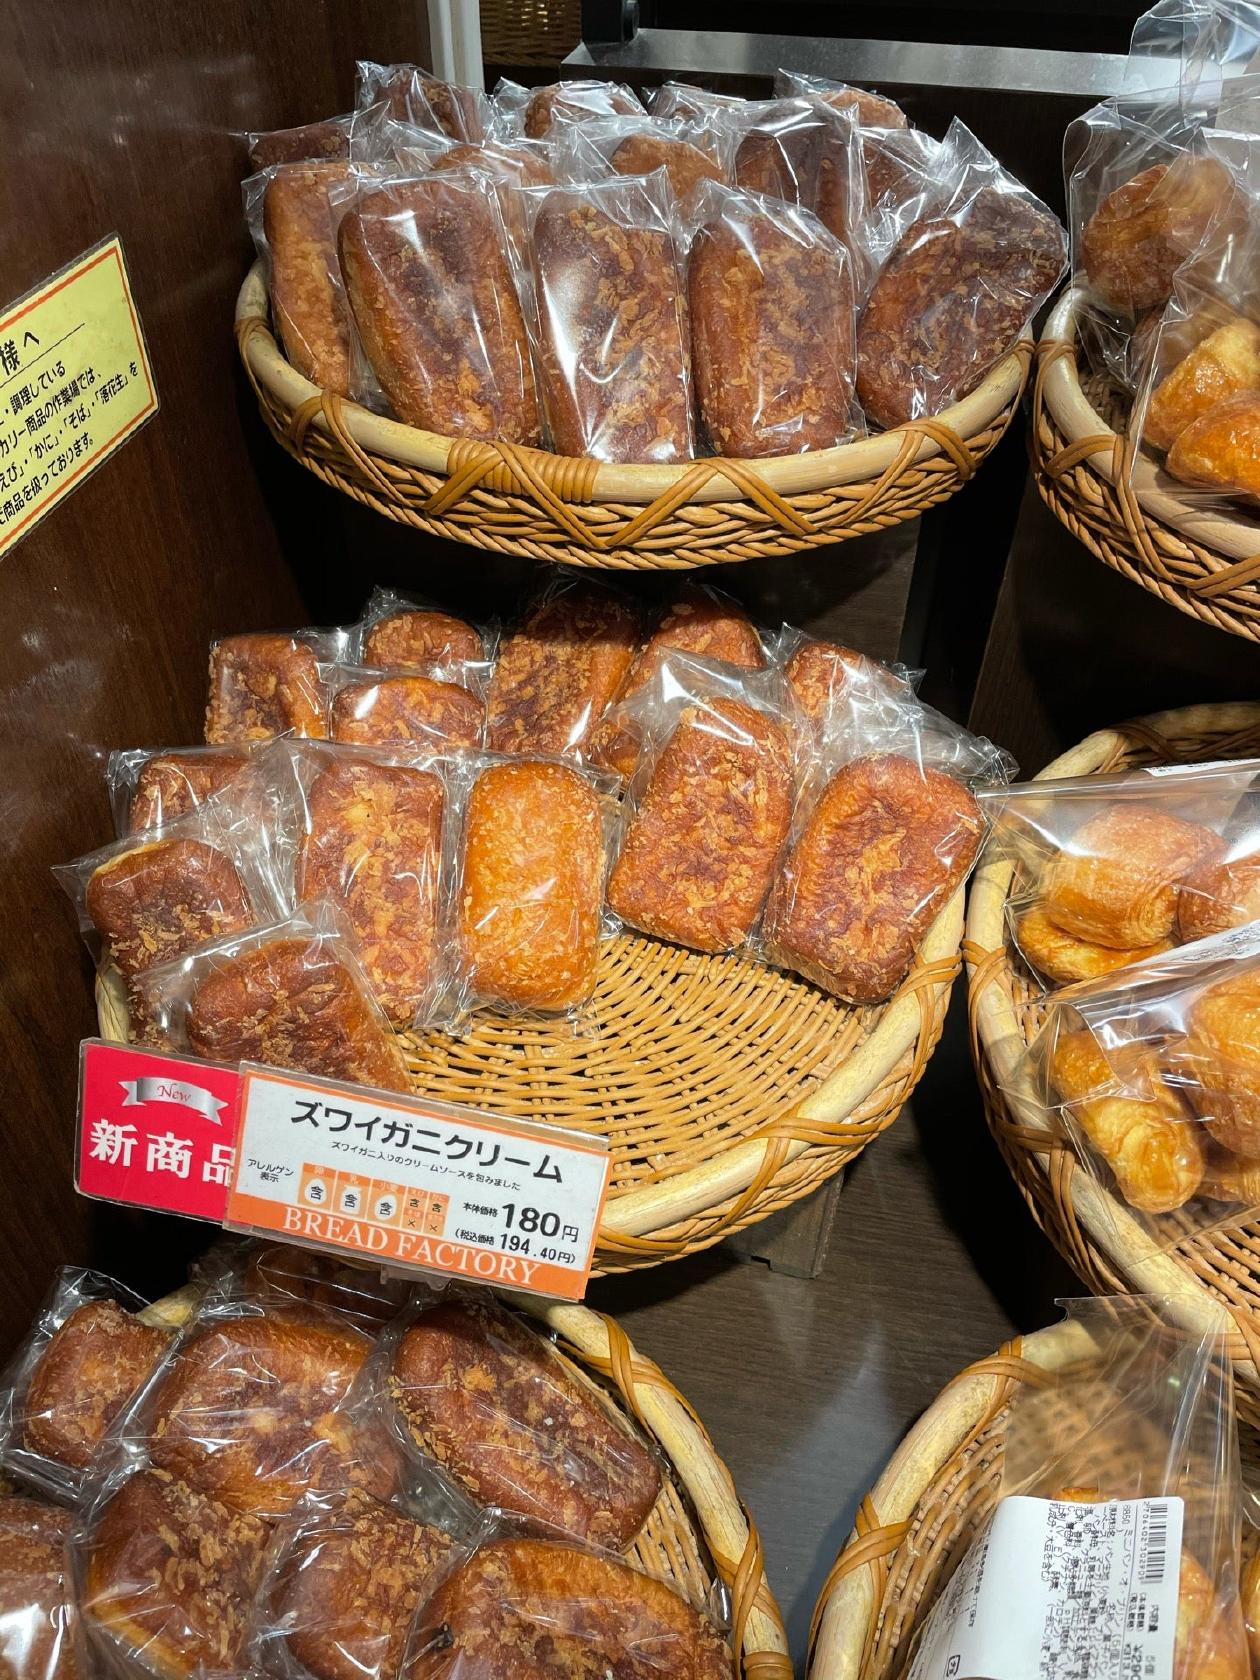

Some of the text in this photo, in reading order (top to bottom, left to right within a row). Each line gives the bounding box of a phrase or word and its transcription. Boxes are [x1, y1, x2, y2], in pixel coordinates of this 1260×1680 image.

[157, 1083, 193, 1103] New
[90, 1118, 236, 1188] 新商品
[290, 1099, 563, 1184] ズワイガニクリーム
[247, 1157, 295, 1177] アレルゲン
[259, 1171, 280, 1183] 表示
[331, 1140, 522, 1192] ズワイガニ入りのクリームソースを包みました
[463, 1201, 498, 1218] 本体価格
[283, 1206, 542, 1286] BREAD FACTORY
